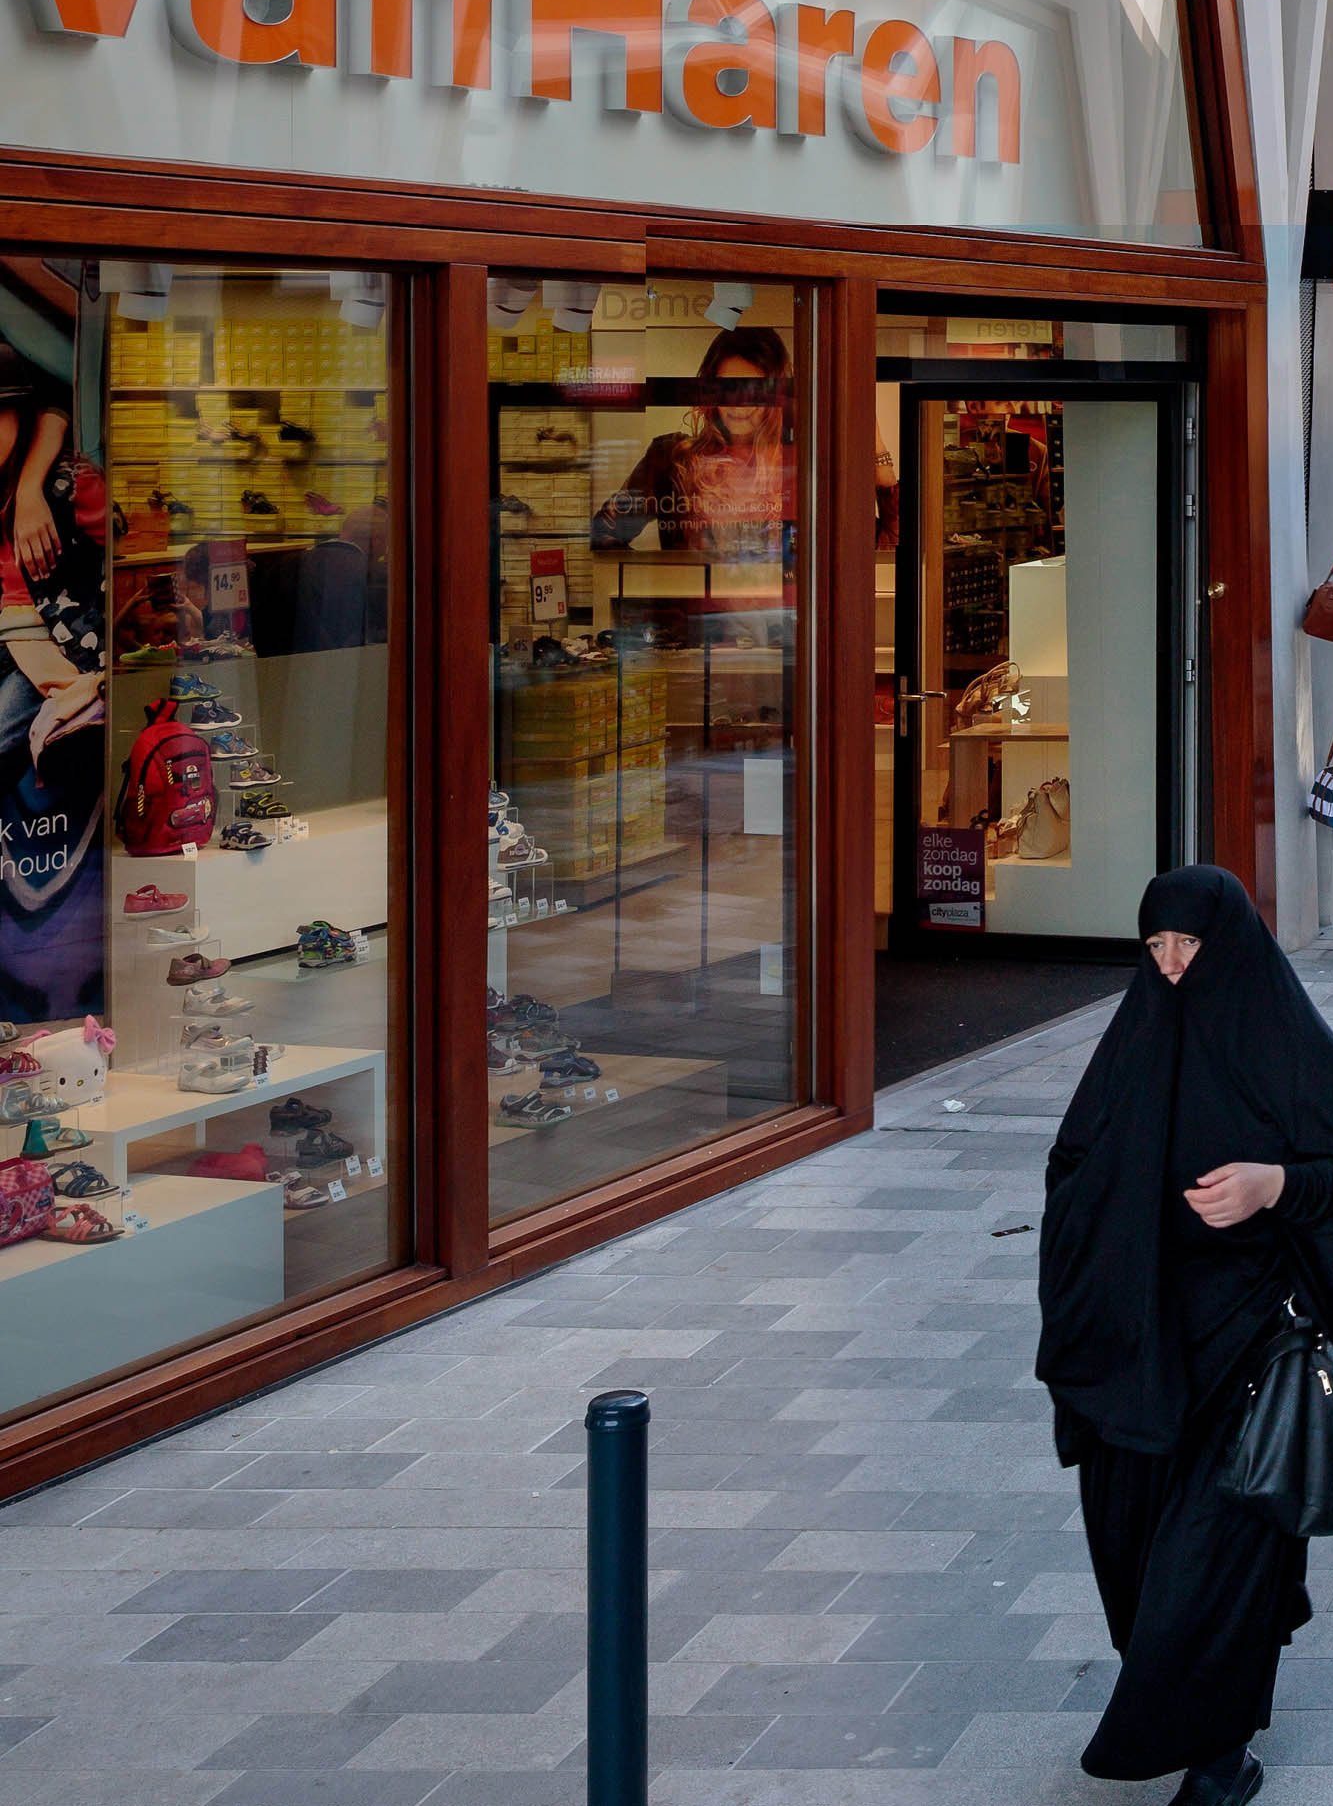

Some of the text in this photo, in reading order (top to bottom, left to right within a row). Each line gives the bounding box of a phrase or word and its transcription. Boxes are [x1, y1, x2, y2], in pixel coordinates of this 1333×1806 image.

[602, 289, 714, 320] Dame
[612, 491, 698, 514] Omdat
[658, 520, 677, 532] op
[21, 813, 68, 839] van
[923, 833, 953, 848] elke
[923, 847, 977, 865] zondag
[923, 861, 962, 879] koop
[923, 878, 980, 894] zondag
[931, 906, 969, 918] cityplaza
